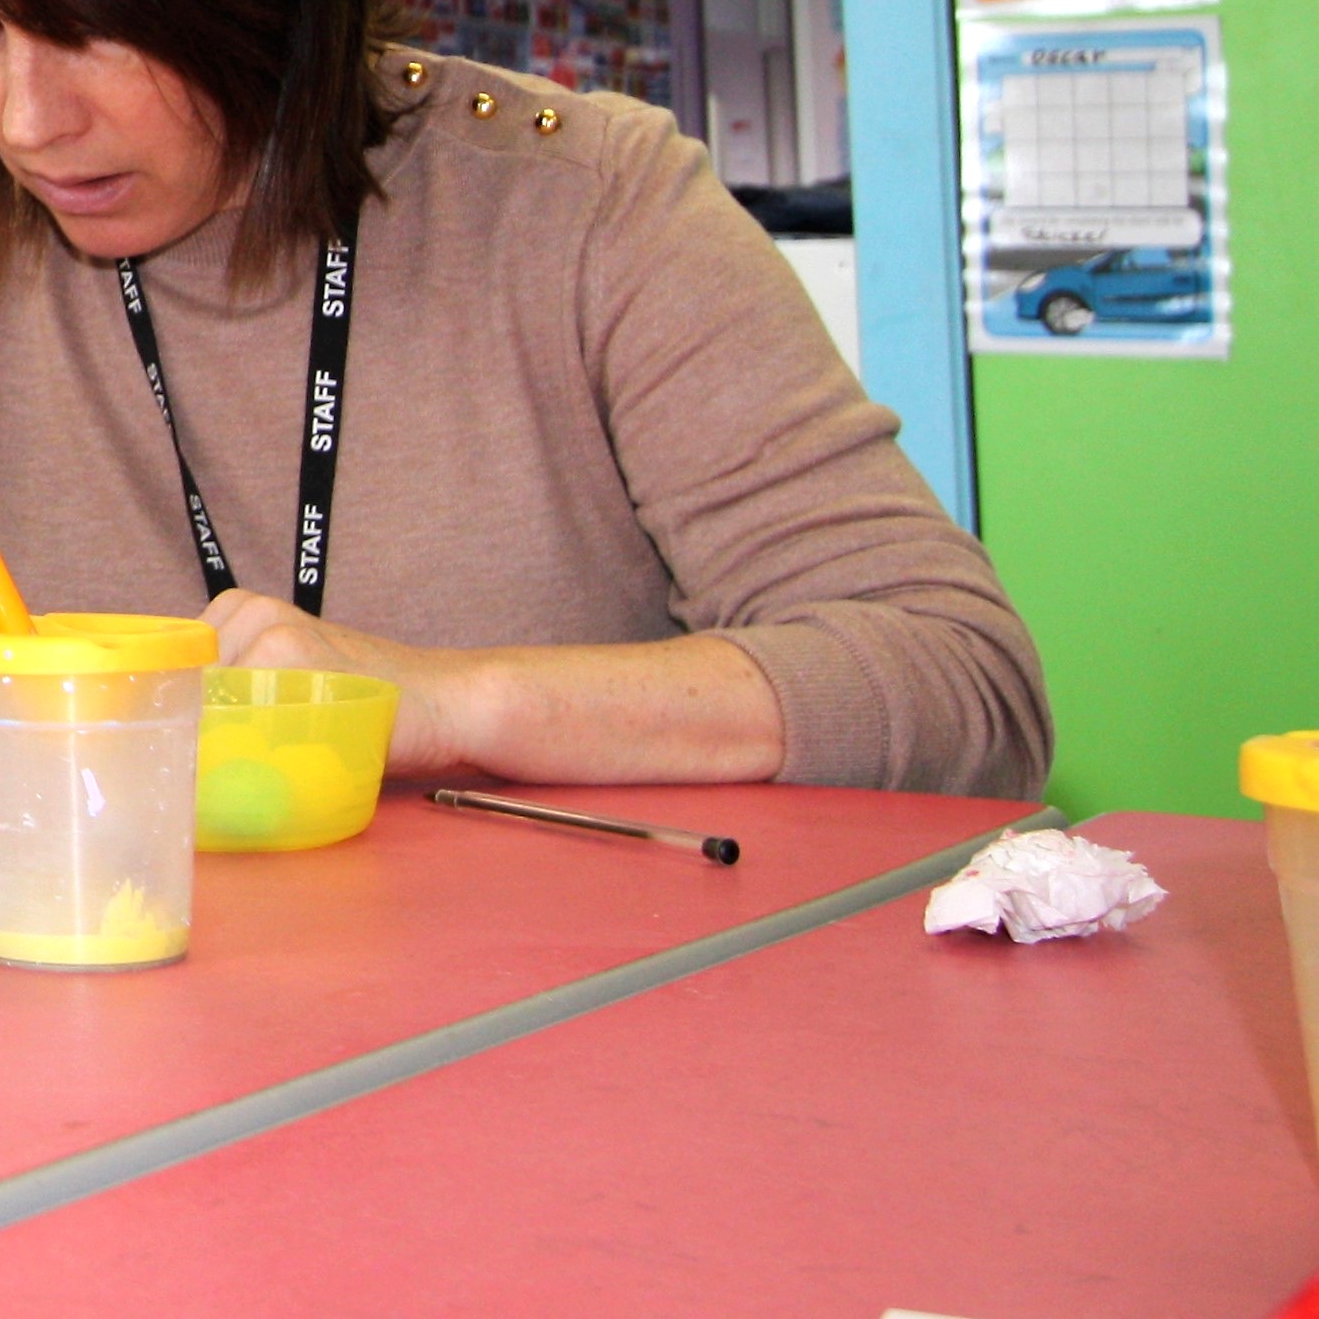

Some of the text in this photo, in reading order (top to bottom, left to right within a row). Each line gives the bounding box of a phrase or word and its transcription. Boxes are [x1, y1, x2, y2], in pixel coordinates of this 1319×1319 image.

[119, 258, 142, 315] TAFF
[310, 370, 338, 451] STAFF
[188, 494, 226, 571] STAFF
[298, 504, 325, 585] STAFF
